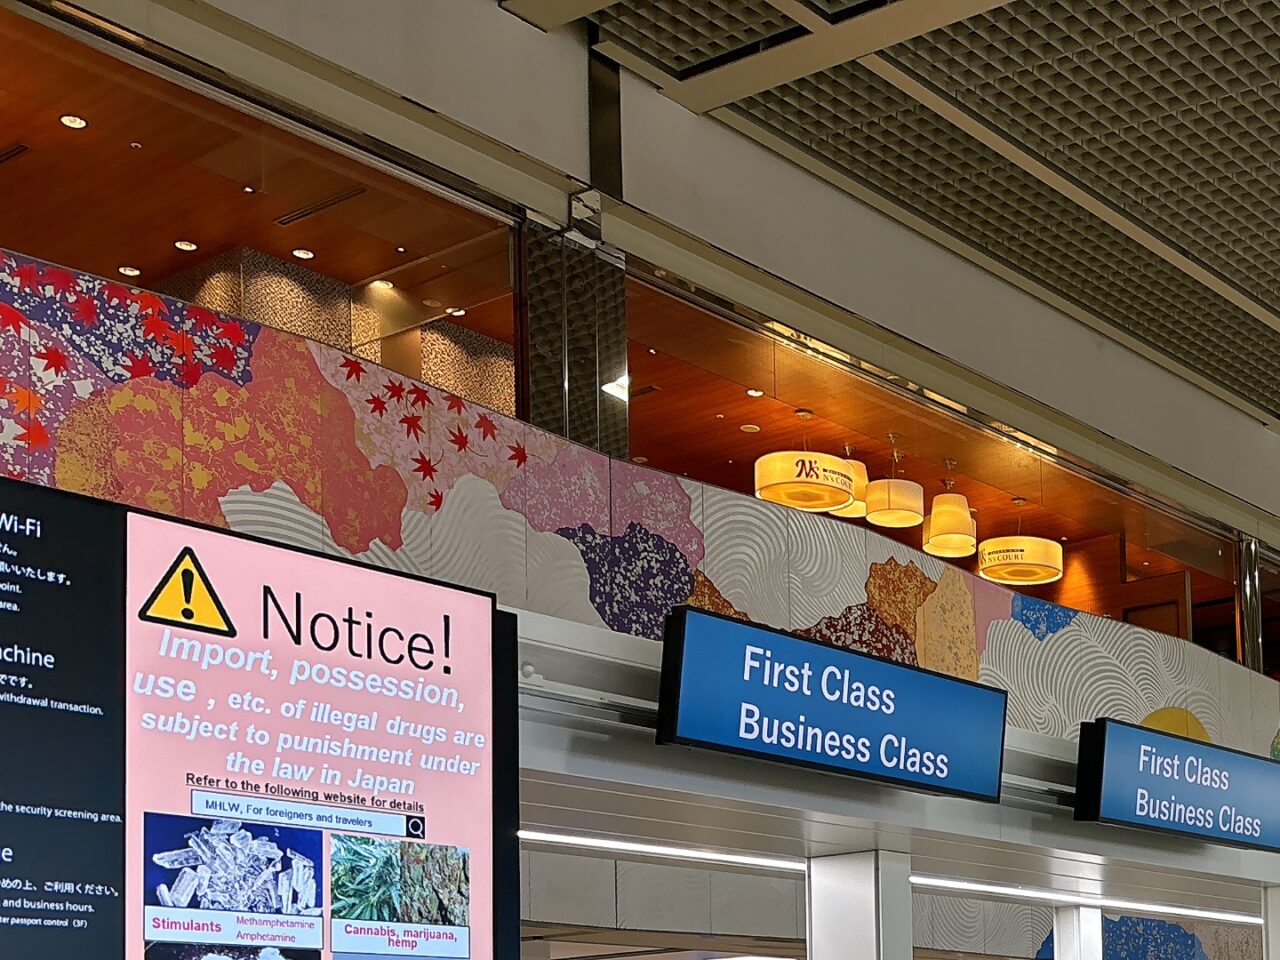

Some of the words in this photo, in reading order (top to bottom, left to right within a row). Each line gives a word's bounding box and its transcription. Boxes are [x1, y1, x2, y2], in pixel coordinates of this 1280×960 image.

[997, 553, 1025, 562] COURT
[0, 582, 23, 594] oint.
[263, 584, 452, 675] Notice!
[0, 644, 55, 669] chine
[159, 628, 278, 680] Import,
[290, 659, 465, 713] possession,
[743, 644, 812, 696] First
[821, 665, 896, 715] Class
[50, 700, 104, 716] transaction.
[133, 672, 197, 701] use
[228, 692, 271, 714] etc.
[280, 700, 306, 719] of
[310, 703, 378, 732] illegal
[386, 716, 448, 744] drugs
[453, 729, 486, 748] are
[141, 711, 238, 741] subject
[246, 724, 270, 745] to
[277, 732, 413, 767] punishment
[420, 753, 481, 776] under
[739, 702, 871, 763] Business
[880, 734, 949, 779] Class
[226, 751, 265, 775] the
[272, 756, 315, 782] law
[320, 763, 341, 785] in
[348, 768, 415, 795] Japan
[1139, 744, 1180, 780] First
[1184, 756, 1230, 791] Class
[186, 773, 220, 789] Refer
[224, 778, 238, 791] to
[241, 780, 261, 793] the
[264, 782, 319, 801] following
[323, 790, 367, 806] website
[371, 794, 387, 807] for
[389, 799, 425, 813] details
[15, 805, 53, 818] security
[54, 808, 99, 823] screening
[100, 812, 122, 823] area.
[205, 800, 243, 814] MHLW,
[246, 804, 262, 815] For
[265, 806, 313, 823] foreigners
[316, 812, 333, 823] and
[335, 815, 373, 827] travelers
[1136, 788, 1214, 829] Business
[1219, 805, 1262, 838] Class
[0, 878, 119, 897] めの上、ご利用ください。
[3, 899, 22, 910] and
[24, 899, 64, 911] business
[66, 901, 95, 913] hours.
[151, 917, 222, 933] Stimulants
[236, 915, 315, 930] Methamphetamine
[344, 923, 399, 939] Cannabis,
[403, 928, 458, 942] marijuana,
[236, 930, 296, 943] Amphetamine
[388, 937, 418, 950] hemp
